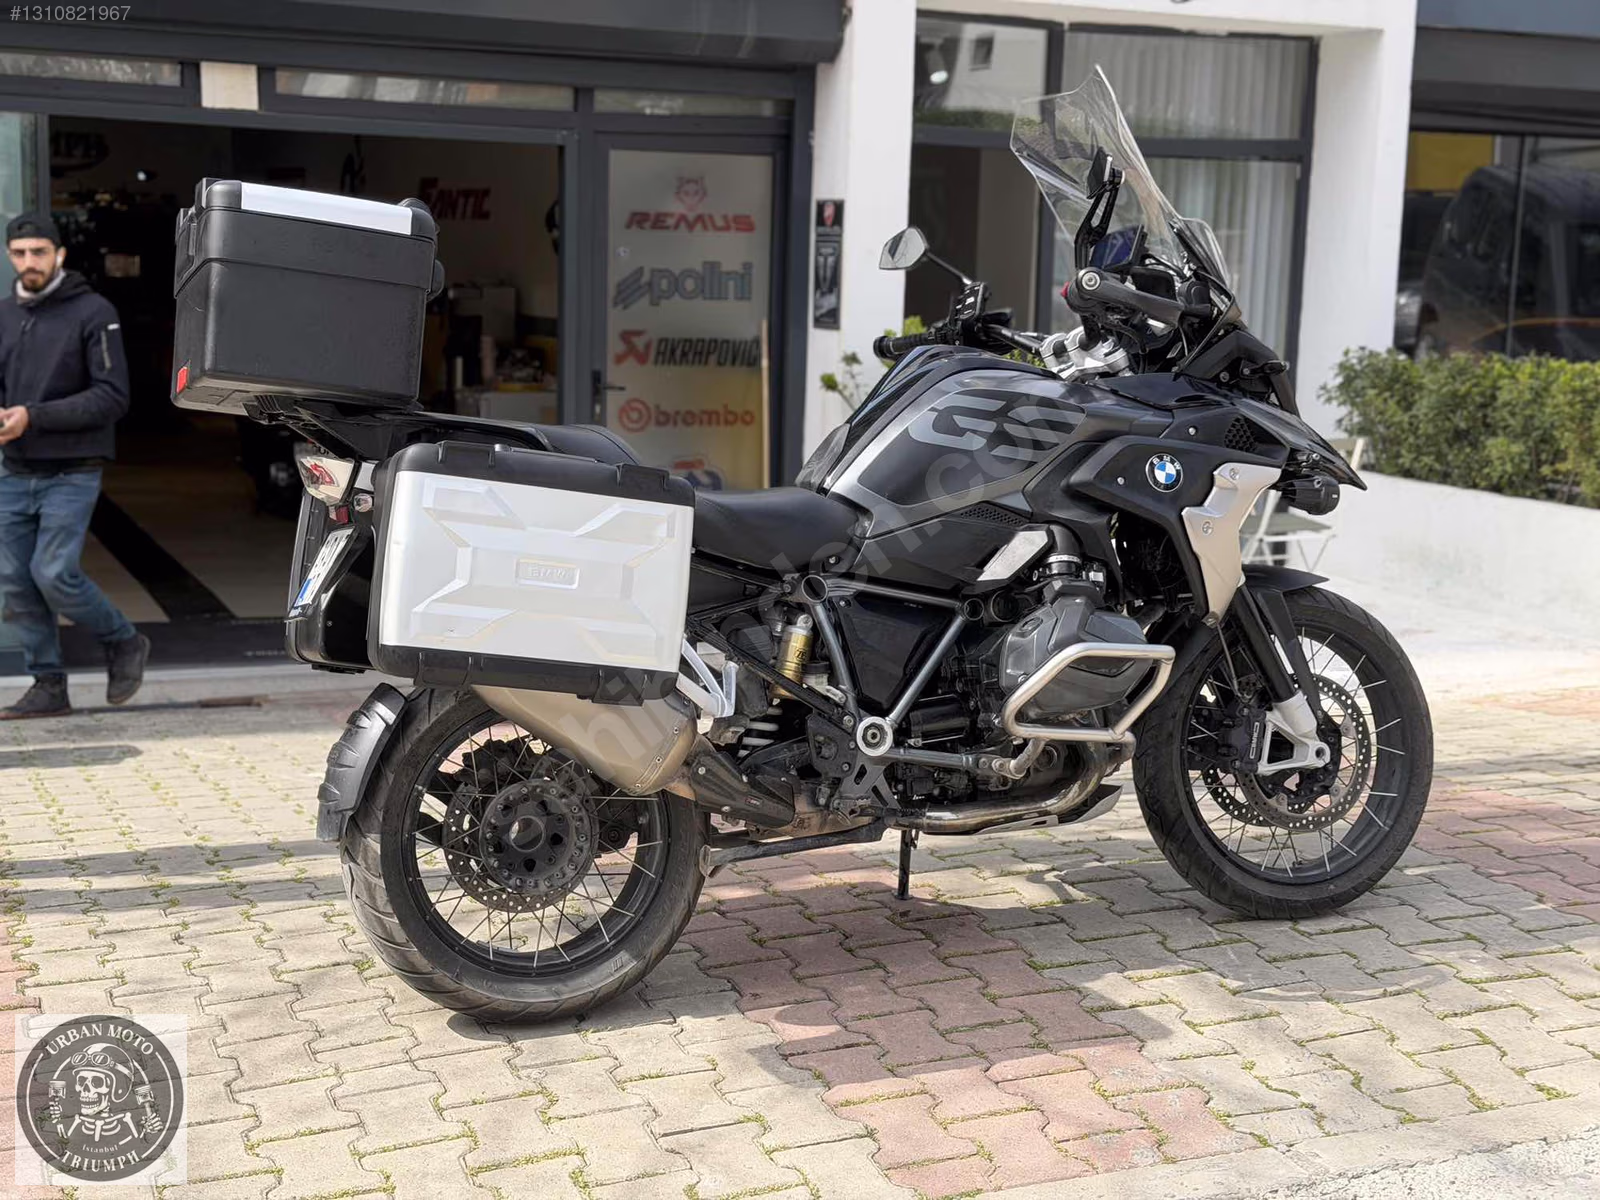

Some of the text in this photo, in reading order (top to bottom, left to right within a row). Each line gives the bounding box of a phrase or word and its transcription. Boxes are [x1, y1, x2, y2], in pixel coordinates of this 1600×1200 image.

[625, 211, 756, 234] REMUS
[650, 261, 753, 306] polini
[655, 404, 755, 428] brembo
[1152, 455, 1181, 470] BMW
